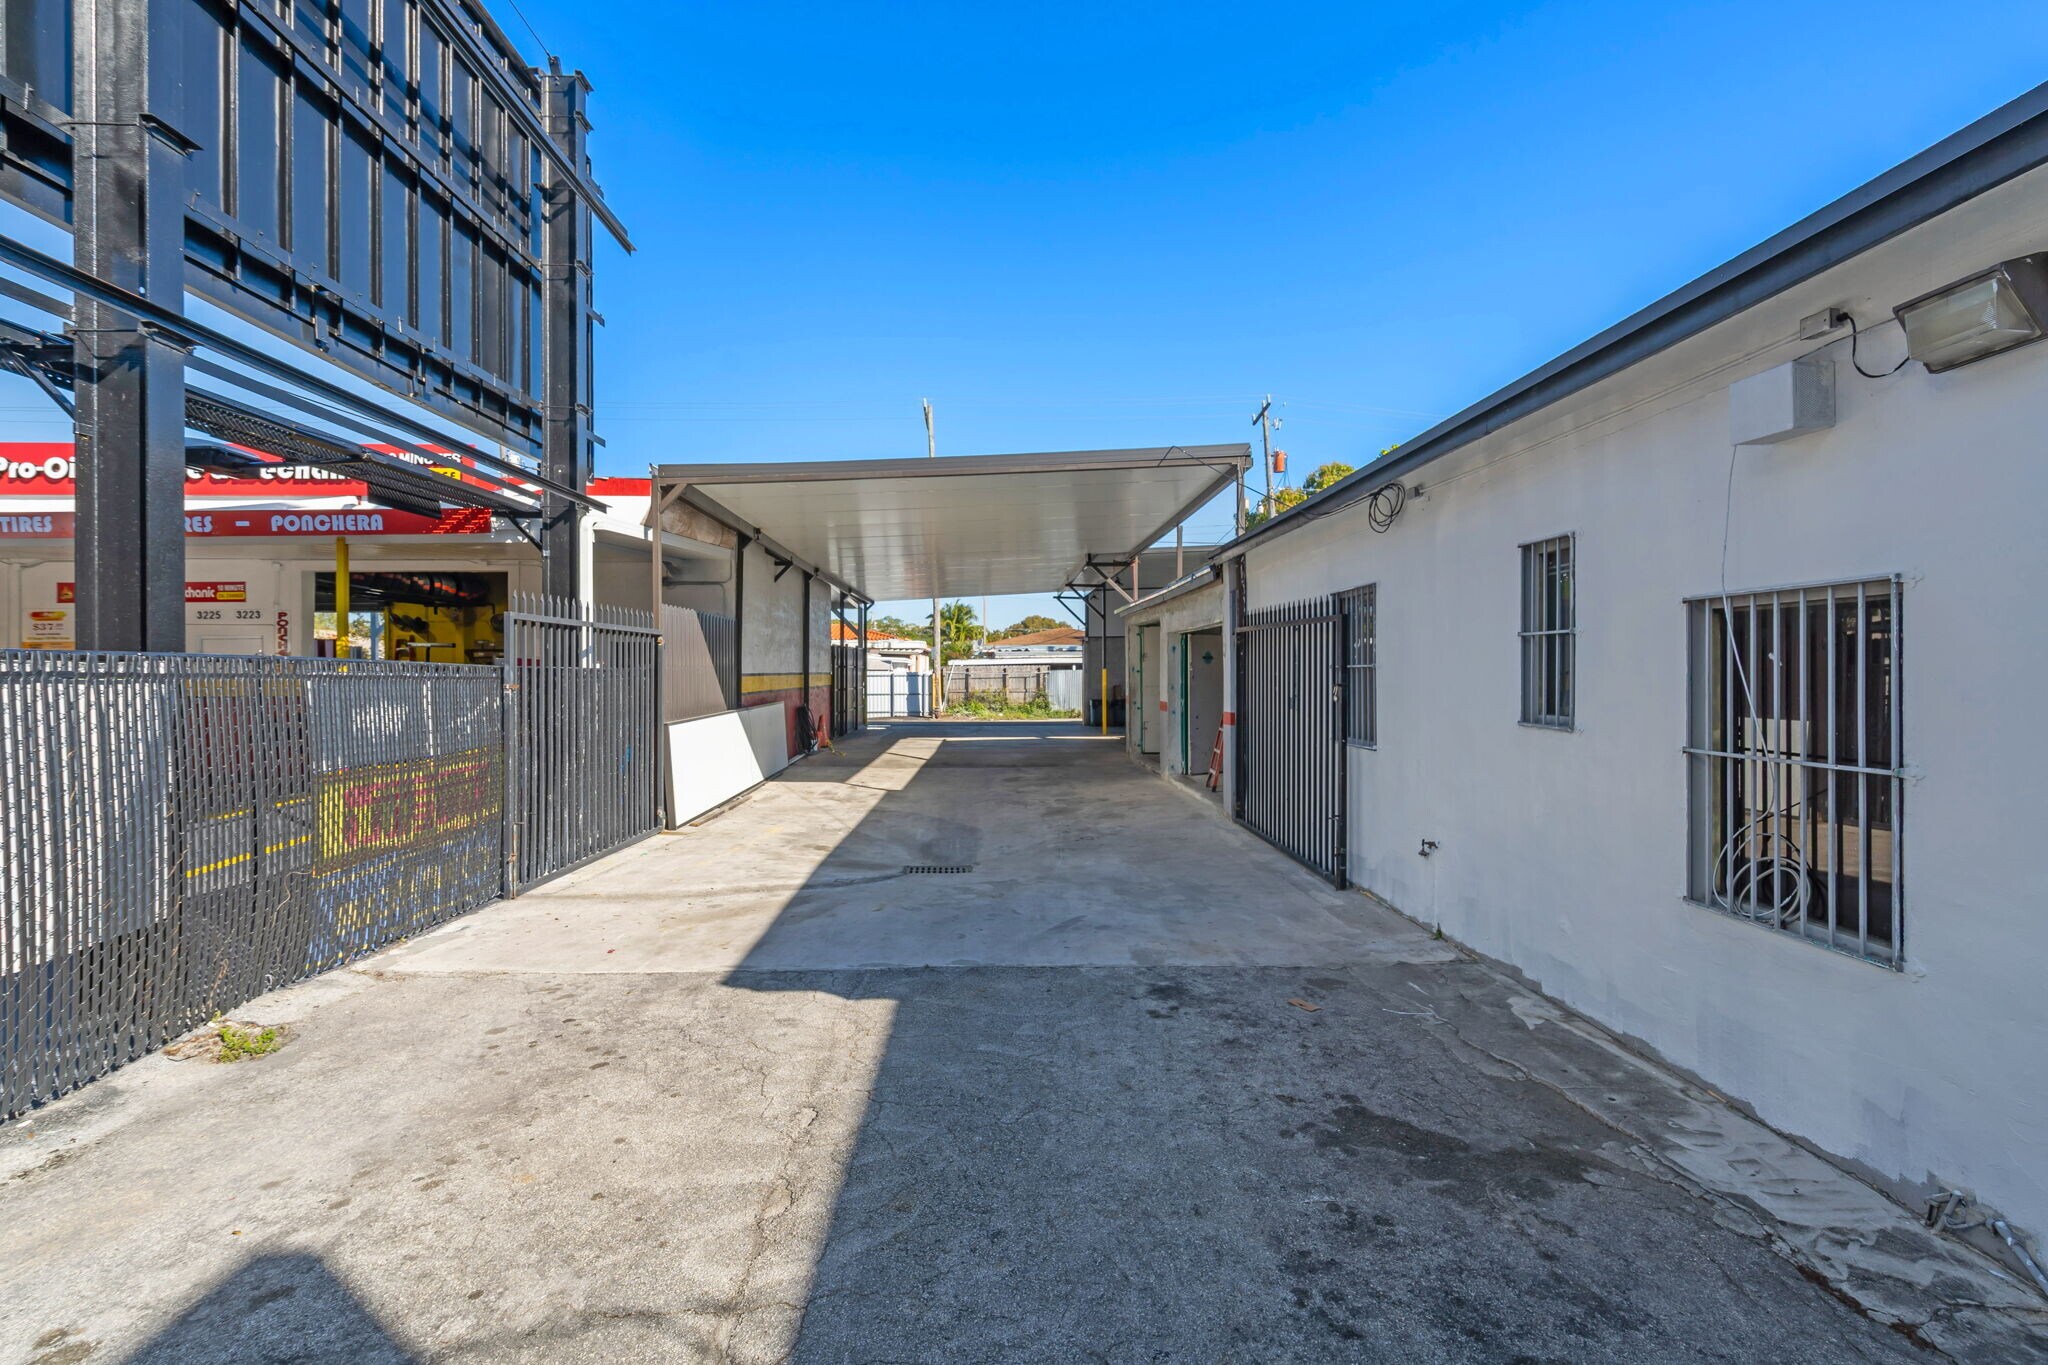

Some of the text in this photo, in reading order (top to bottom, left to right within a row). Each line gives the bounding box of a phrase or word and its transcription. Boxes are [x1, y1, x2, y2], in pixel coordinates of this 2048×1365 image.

[0, 515, 53, 533] TIRES
[271, 513, 384, 532] PONCHERA
[196, 610, 261, 620] 3225 3223
